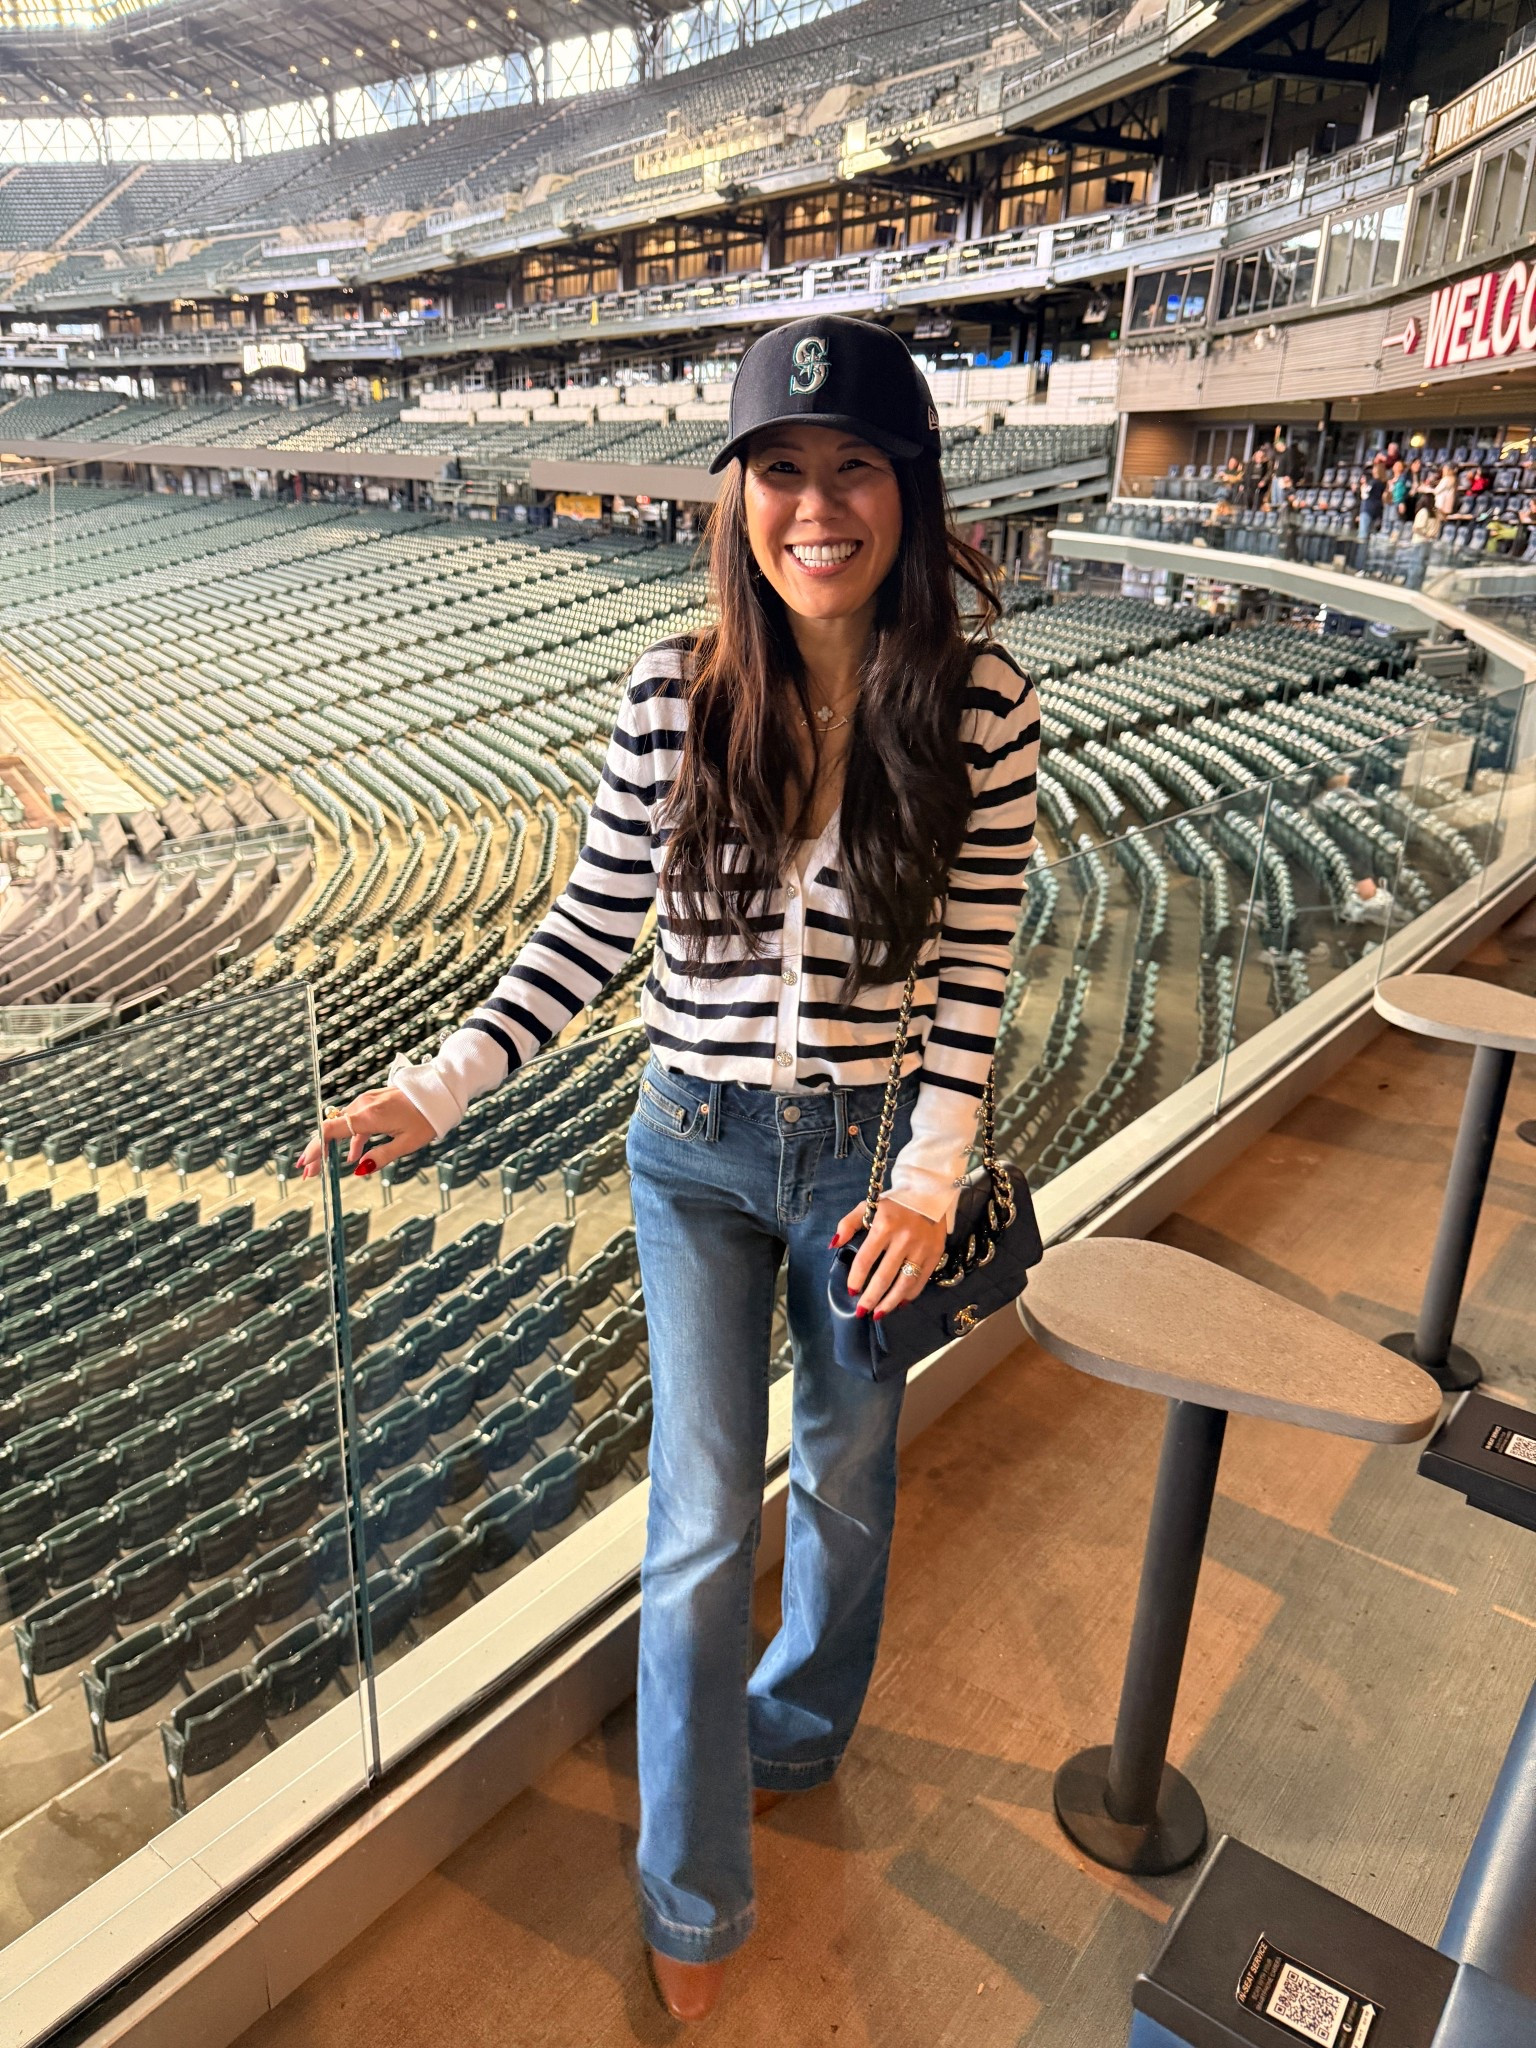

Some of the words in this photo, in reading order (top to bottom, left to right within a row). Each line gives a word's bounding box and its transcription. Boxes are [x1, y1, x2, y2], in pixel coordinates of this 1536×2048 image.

[1435, 95, 1475, 155] DAVE
[1239, 1971, 1255, 2002] IN-SEAT
[1250, 1941, 1268, 1974] SERVICE
